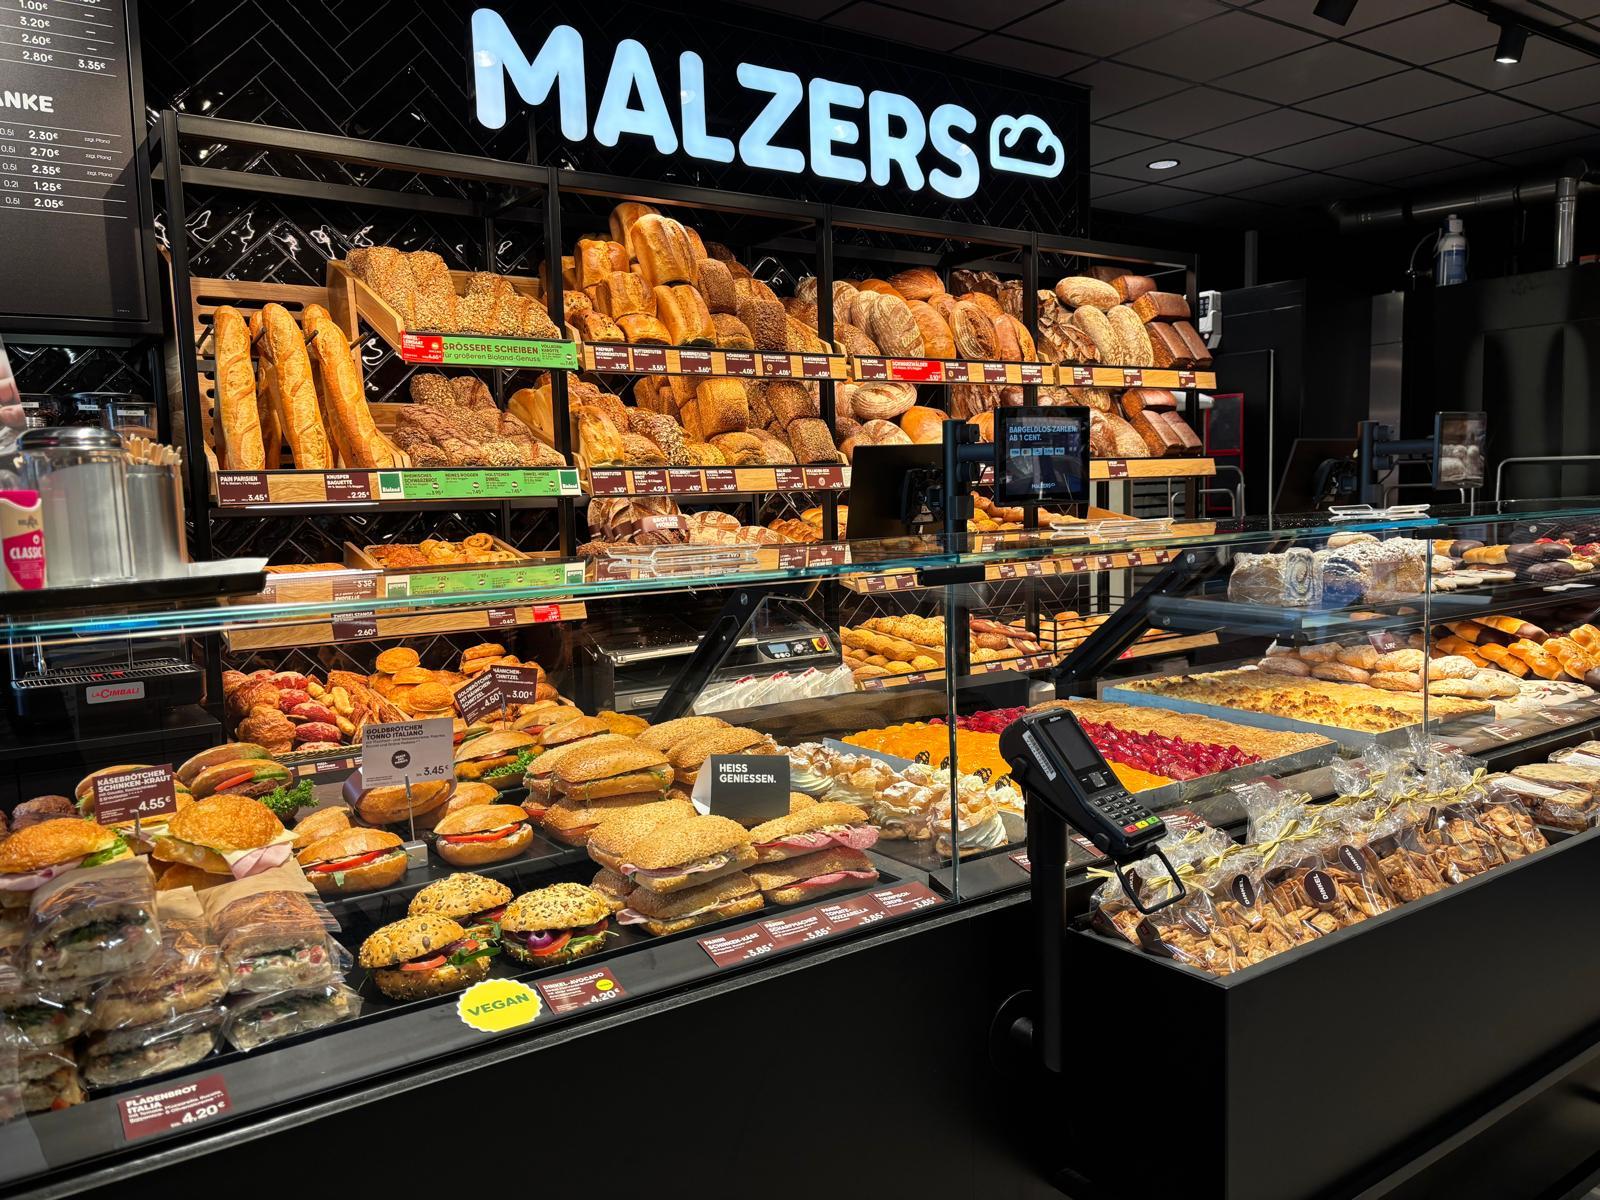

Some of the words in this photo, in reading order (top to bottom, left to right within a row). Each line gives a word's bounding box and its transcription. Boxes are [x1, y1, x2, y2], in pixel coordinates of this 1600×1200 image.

[20, 16, 50, 28] 3.20€
[22, 34, 52, 45] 2.60€
[22, 51, 53, 62] 2.80€
[78, 59, 106, 70] 3.35€
[471, 8, 980, 199] MALZERS
[28, 130, 58, 141] 2.30€
[30, 147, 60, 158] 2.70€
[31, 164, 61, 175] 2.35€
[33, 181, 62, 191] 1.25€
[34, 198, 64, 209] 2.05€
[443, 342, 492, 352] GRÖSSERE
[495, 346, 538, 354] SCHEIBEN
[512, 690, 534, 699] 3.00€
[366, 724, 423, 734] GOLDBRÖTCHEN
[392, 730, 424, 738] ITALIANO
[423, 765, 449, 776] 3.45€
[719, 764, 748, 773] HEISS
[97, 769, 165, 786] KÄSEBRÖTCHEN
[98, 774, 171, 793] SCHINKEN-KRAUT
[719, 774, 777, 784] GENIESSEN.
[138, 795, 171, 811] 4.55€
[1345, 847, 1361, 871] DINKEL
[1313, 873, 1328, 900] DINKEL
[543, 972, 604, 990] DINKEL-AVOCADO
[590, 988, 620, 1004] 4.20€
[467, 992, 530, 1017] VEGAN
[126, 1084, 198, 1107] FLADENBROT
[127, 1101, 163, 1115] ITALIA
